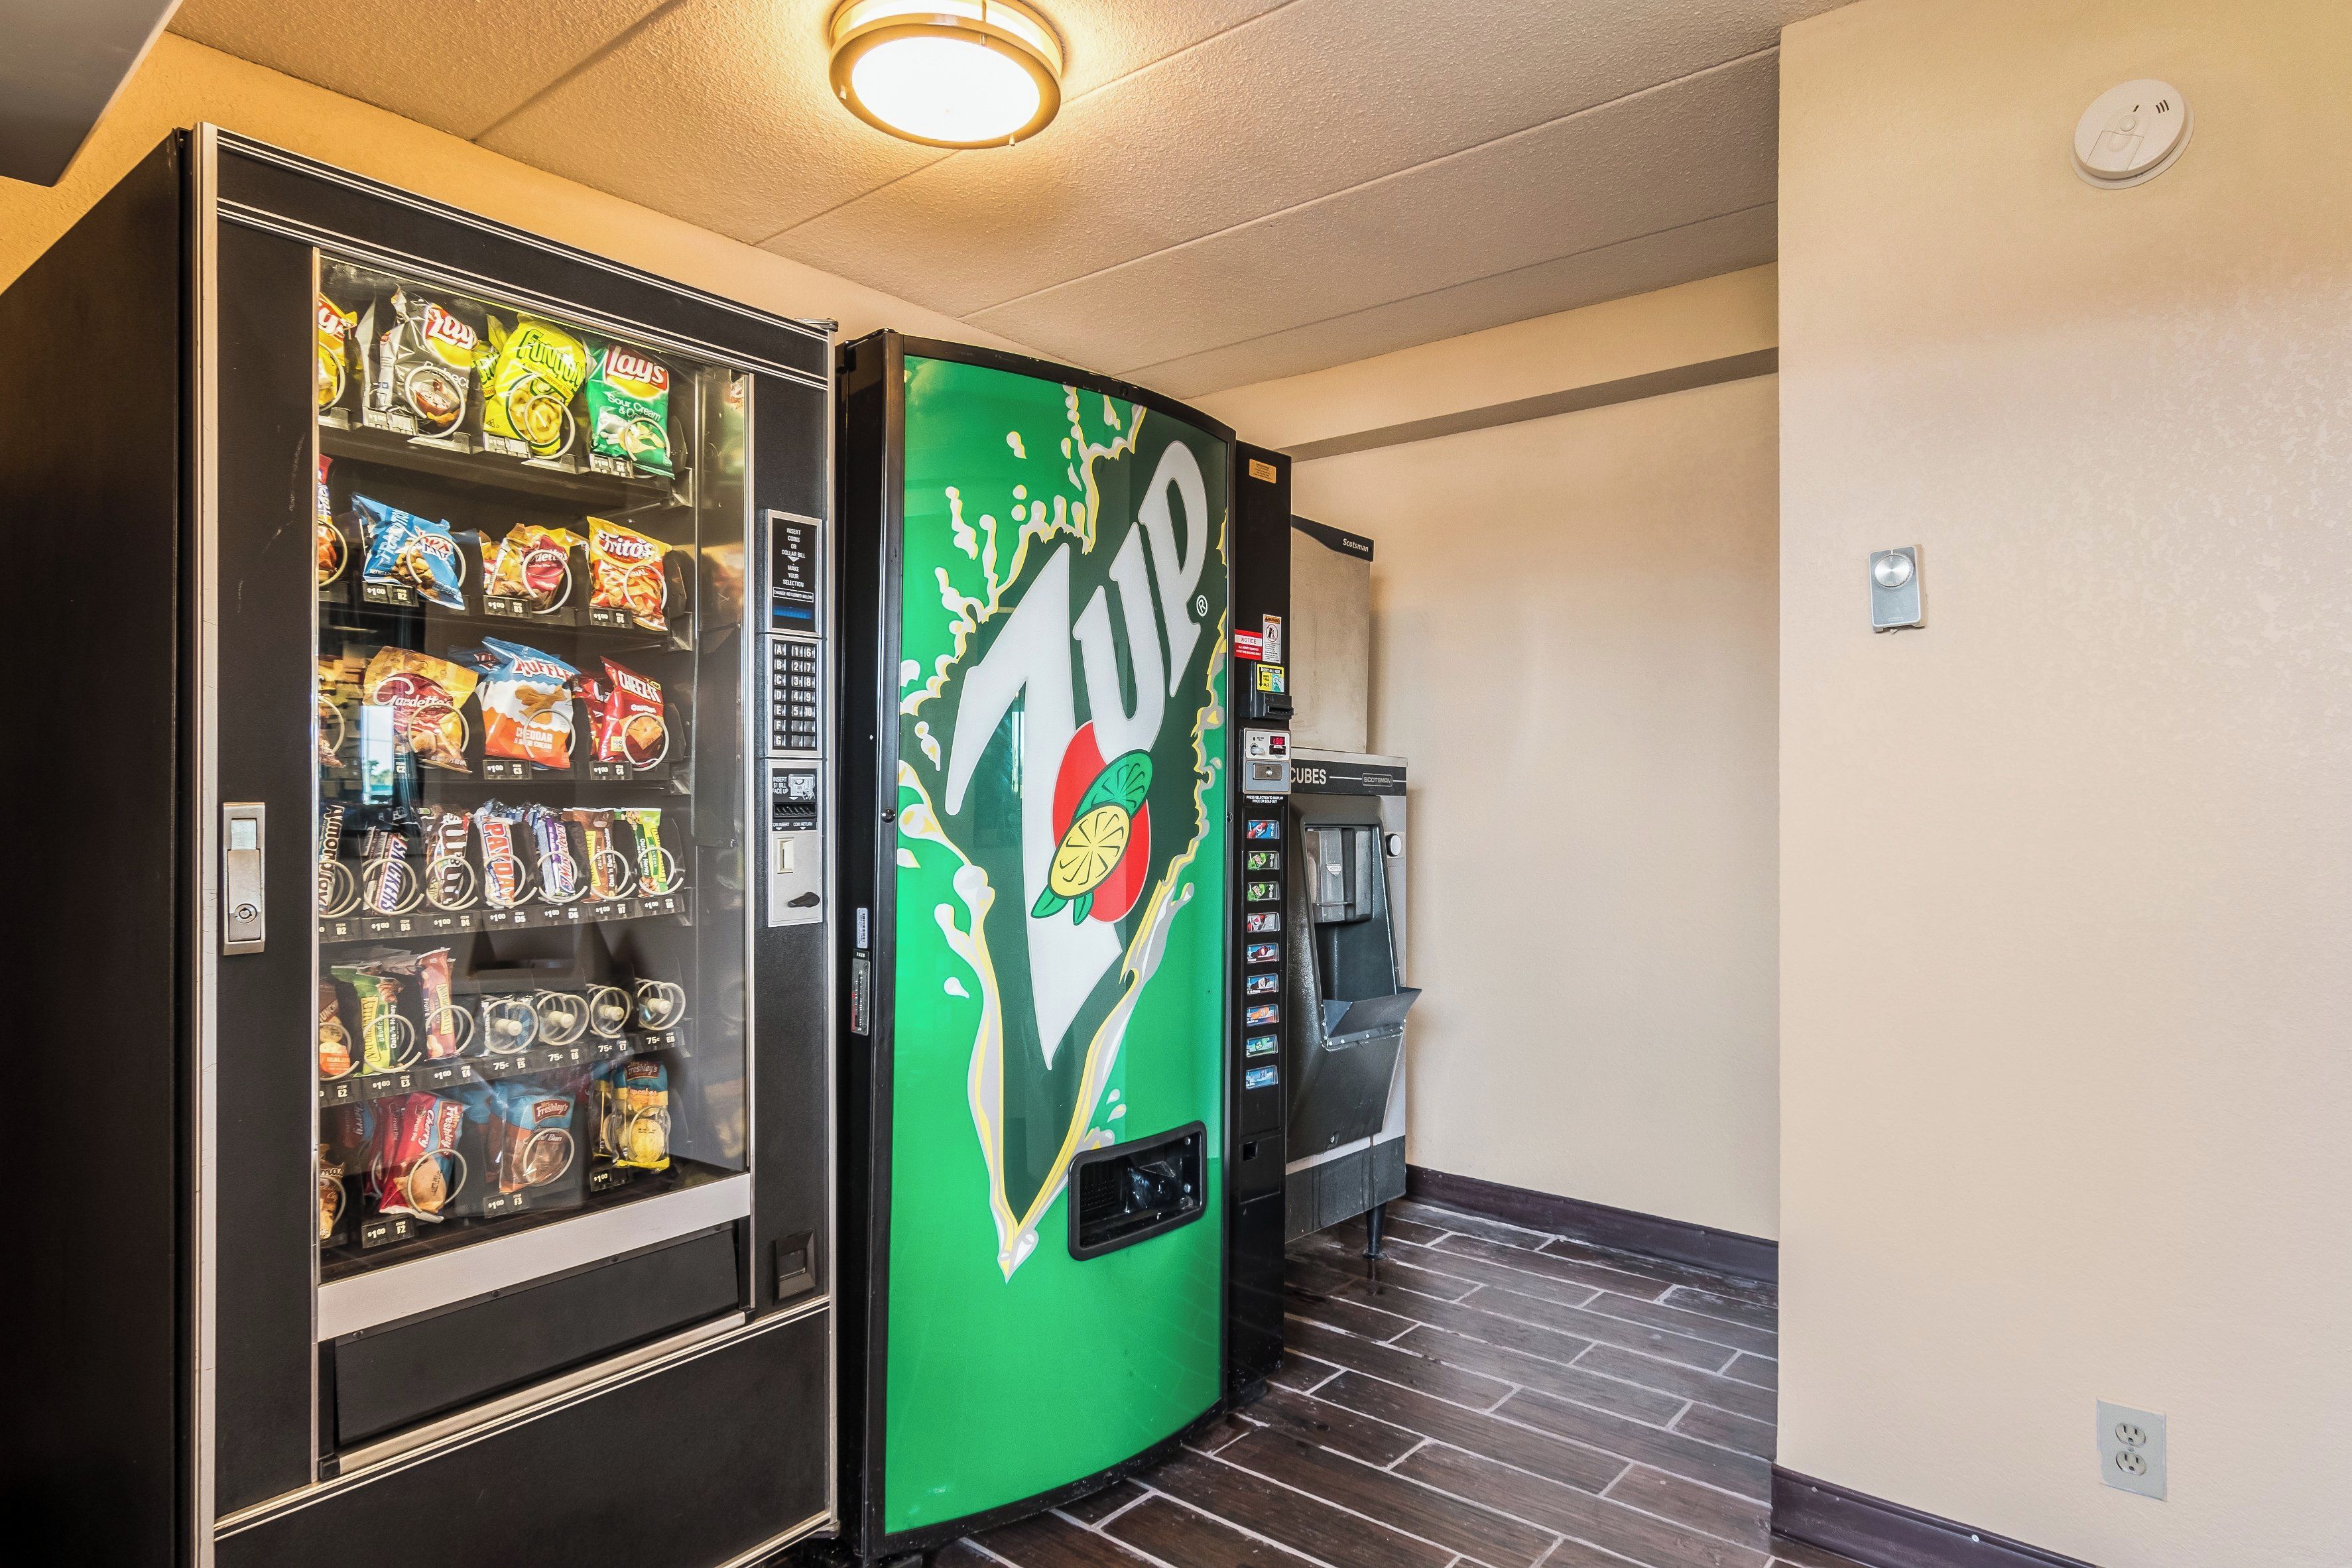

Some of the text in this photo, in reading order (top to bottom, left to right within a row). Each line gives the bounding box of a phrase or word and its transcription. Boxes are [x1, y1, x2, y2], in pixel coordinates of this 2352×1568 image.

[607, 394, 661, 421] Sour Cream
[619, 406, 625, 415] &
[1343, 538, 1369, 552] Scotsman
[782, 579, 804, 587] SELECTION
[776, 644, 812, 657] A 1 6
[776, 659, 811, 672] B 2 7
[617, 670, 662, 704] CHEEZ-IT
[776, 674, 812, 687] C 3 8
[776, 690, 811, 702] D 4 9
[776, 705, 812, 717] E 5 10
[776, 721, 781, 731] F
[516, 727, 553, 743] CHEDDAR
[776, 735, 782, 745] G
[1290, 766, 1327, 785] CUBES
[381, 839, 408, 912] SNICKERS
[536, 1103, 568, 1117] Freshley's
[418, 1109, 434, 1148] Cherry
[548, 1133, 563, 1142] Bun
